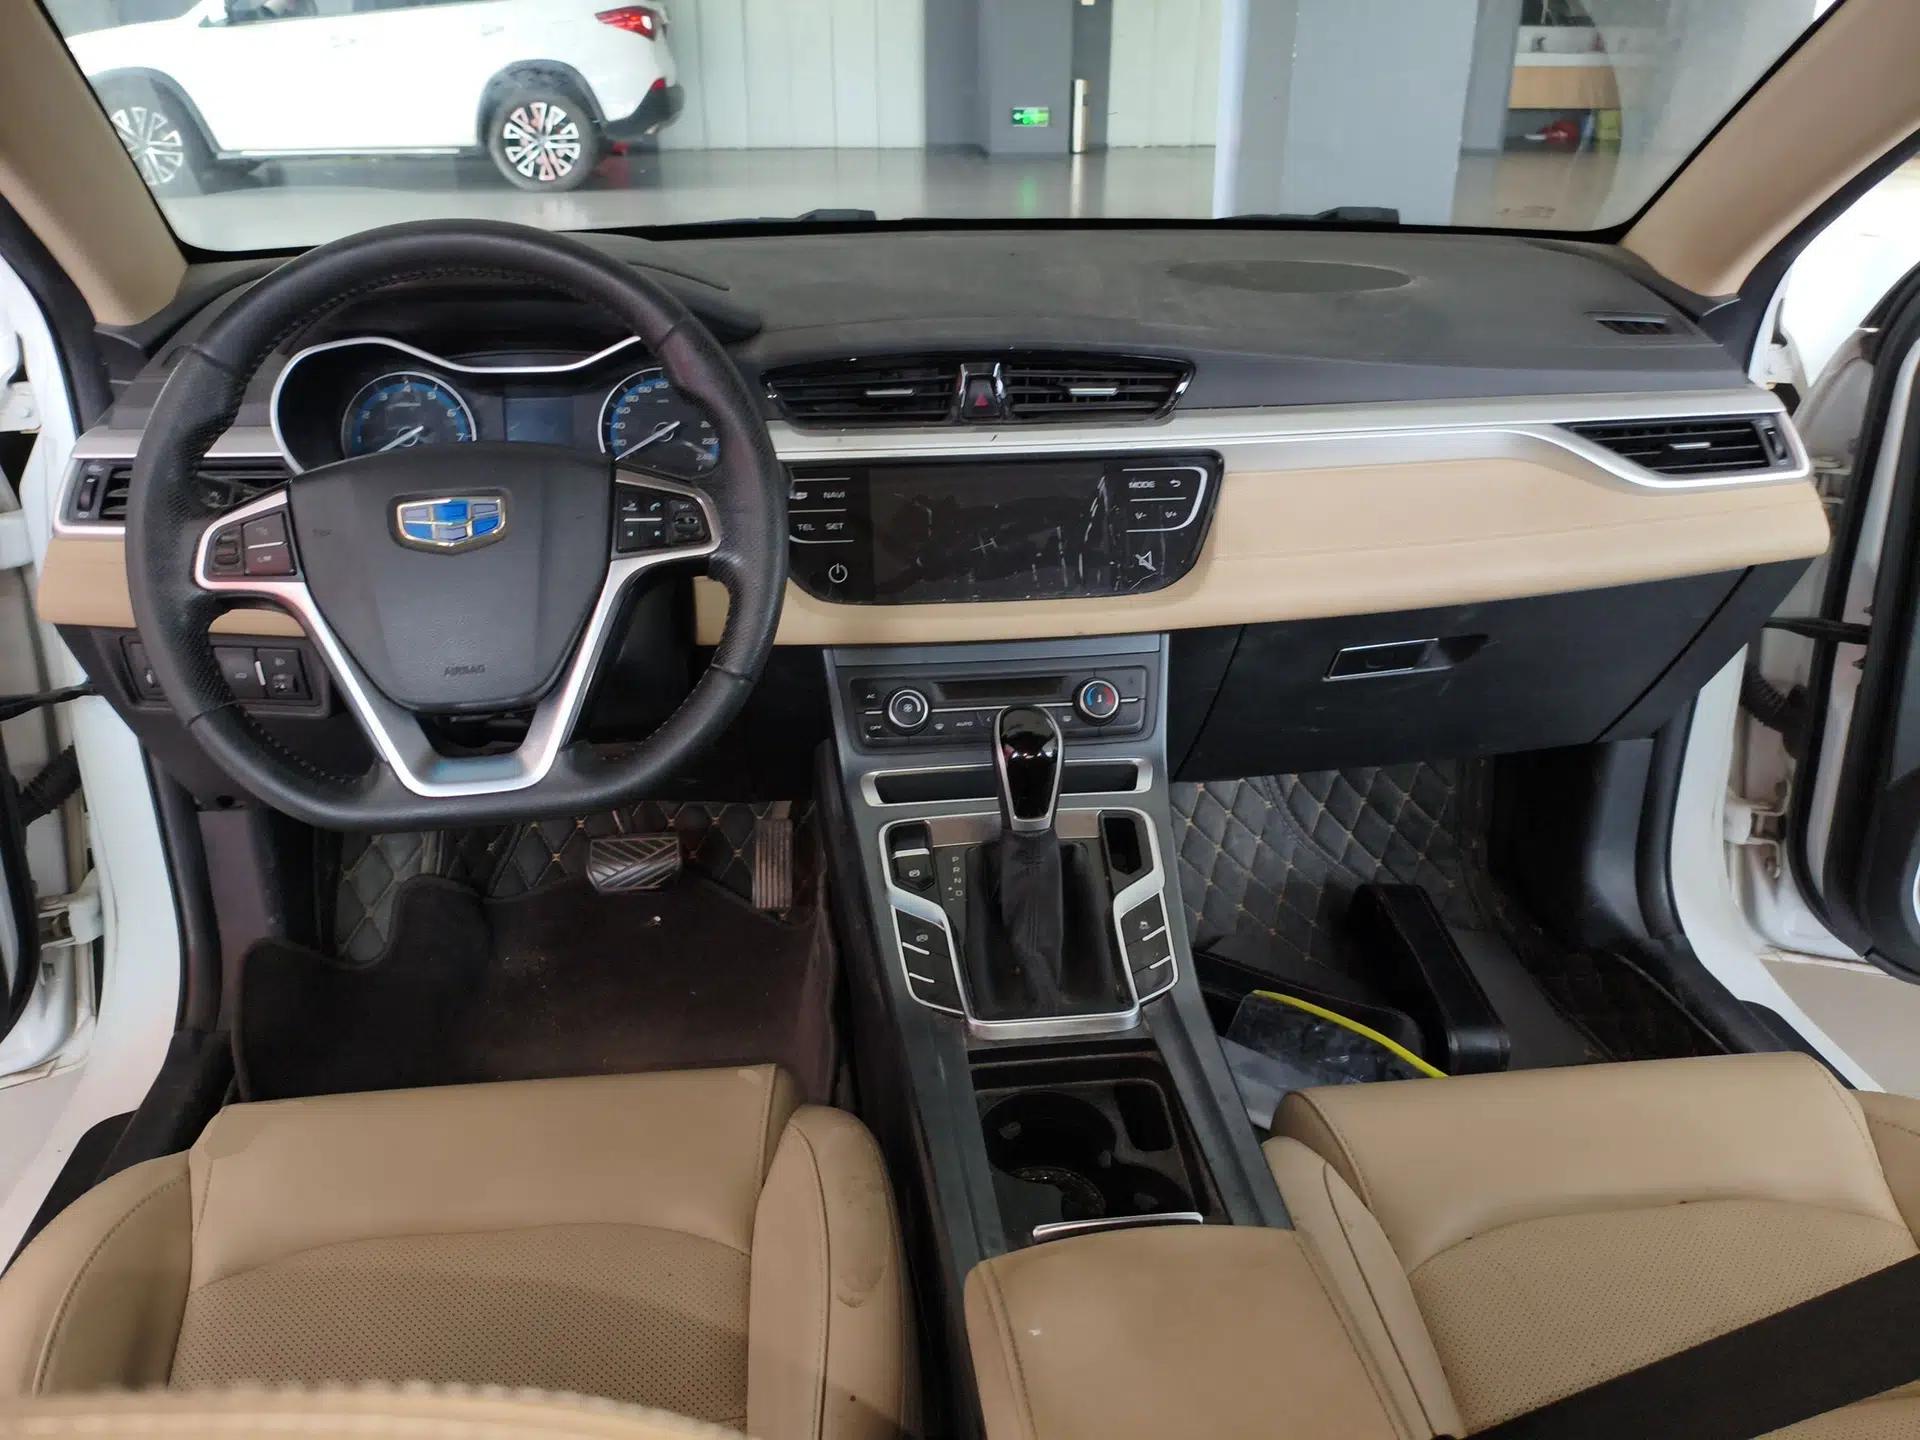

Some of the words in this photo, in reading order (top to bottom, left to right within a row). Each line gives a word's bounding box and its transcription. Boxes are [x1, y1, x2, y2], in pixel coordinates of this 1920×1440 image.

[1128, 480, 1156, 489] MODE
[823, 490, 846, 499] NAVI
[797, 523, 816, 531] TEL
[825, 522, 845, 530] SET
[444, 664, 486, 676] AIRBAG
